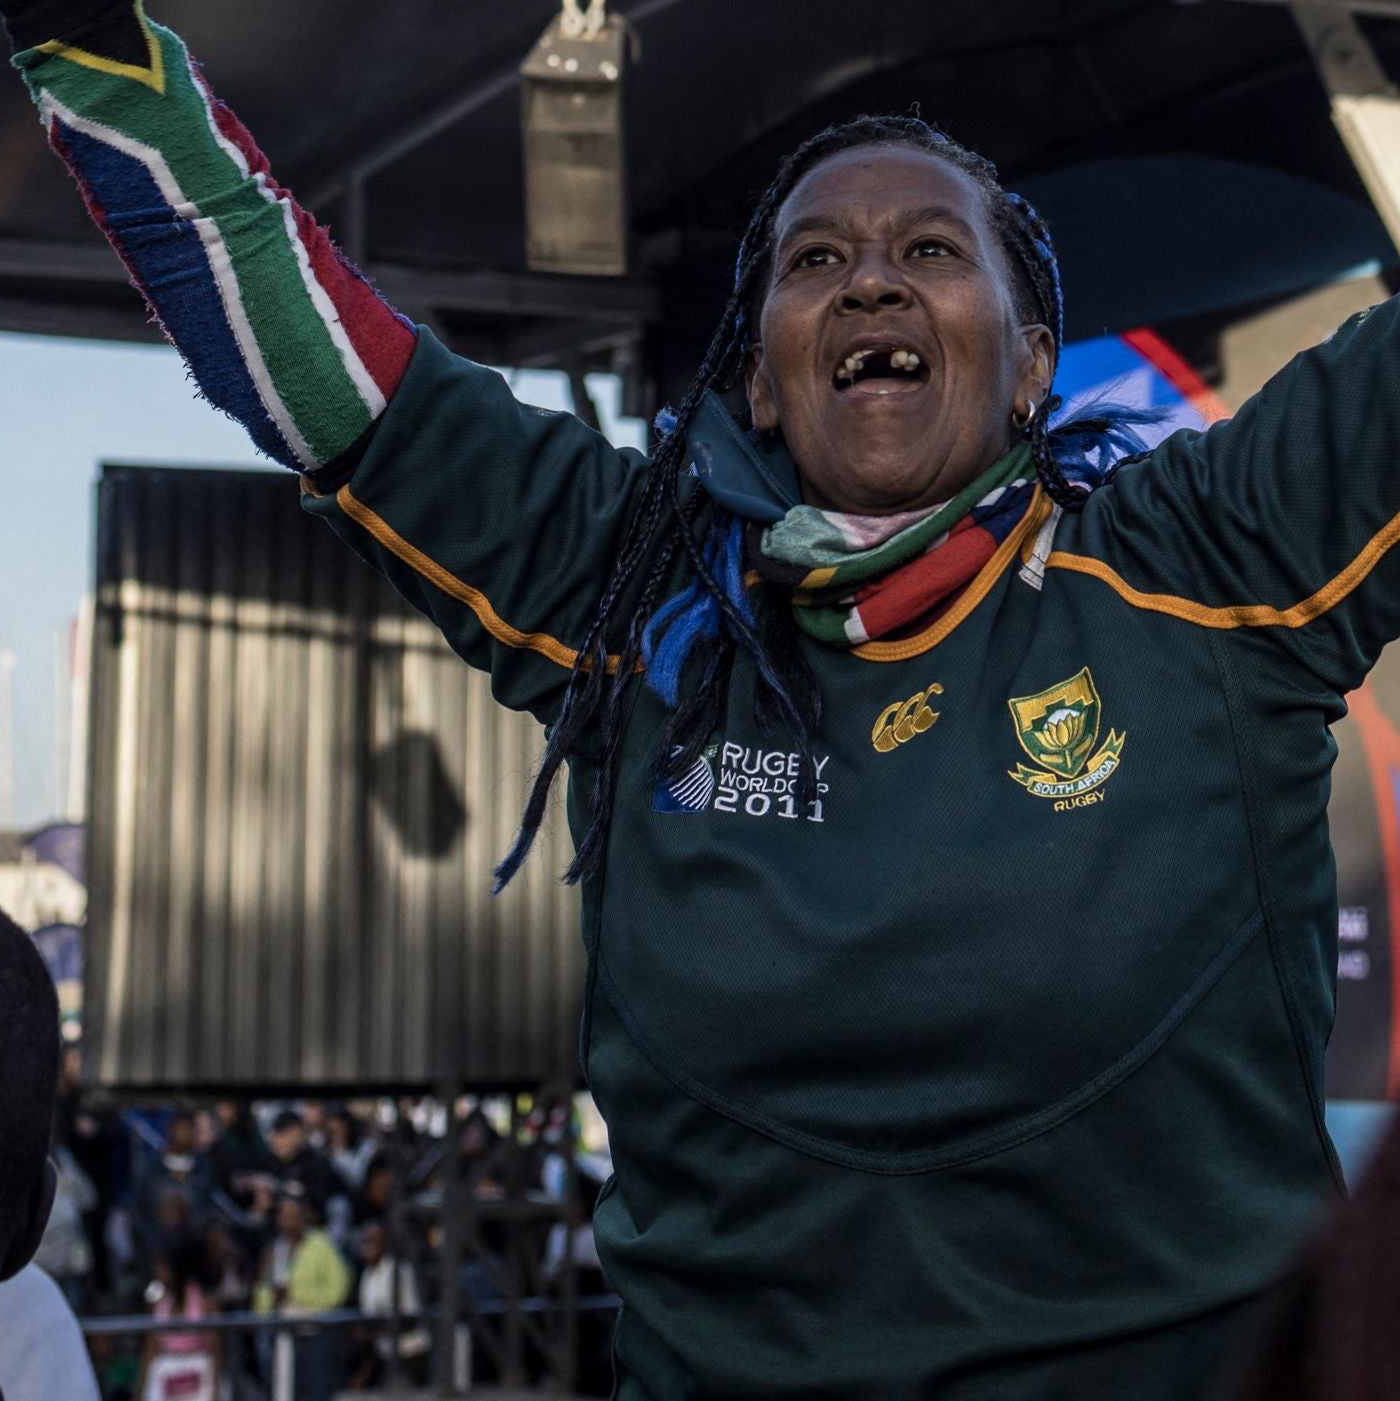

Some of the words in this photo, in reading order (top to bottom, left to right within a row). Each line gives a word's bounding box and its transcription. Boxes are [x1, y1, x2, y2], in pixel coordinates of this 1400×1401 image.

[1033, 782, 1074, 795] SOUTH
[1077, 760, 1116, 791] AFRICA
[714, 785, 825, 822] 2011
[1054, 788, 1106, 812] RUGBY
